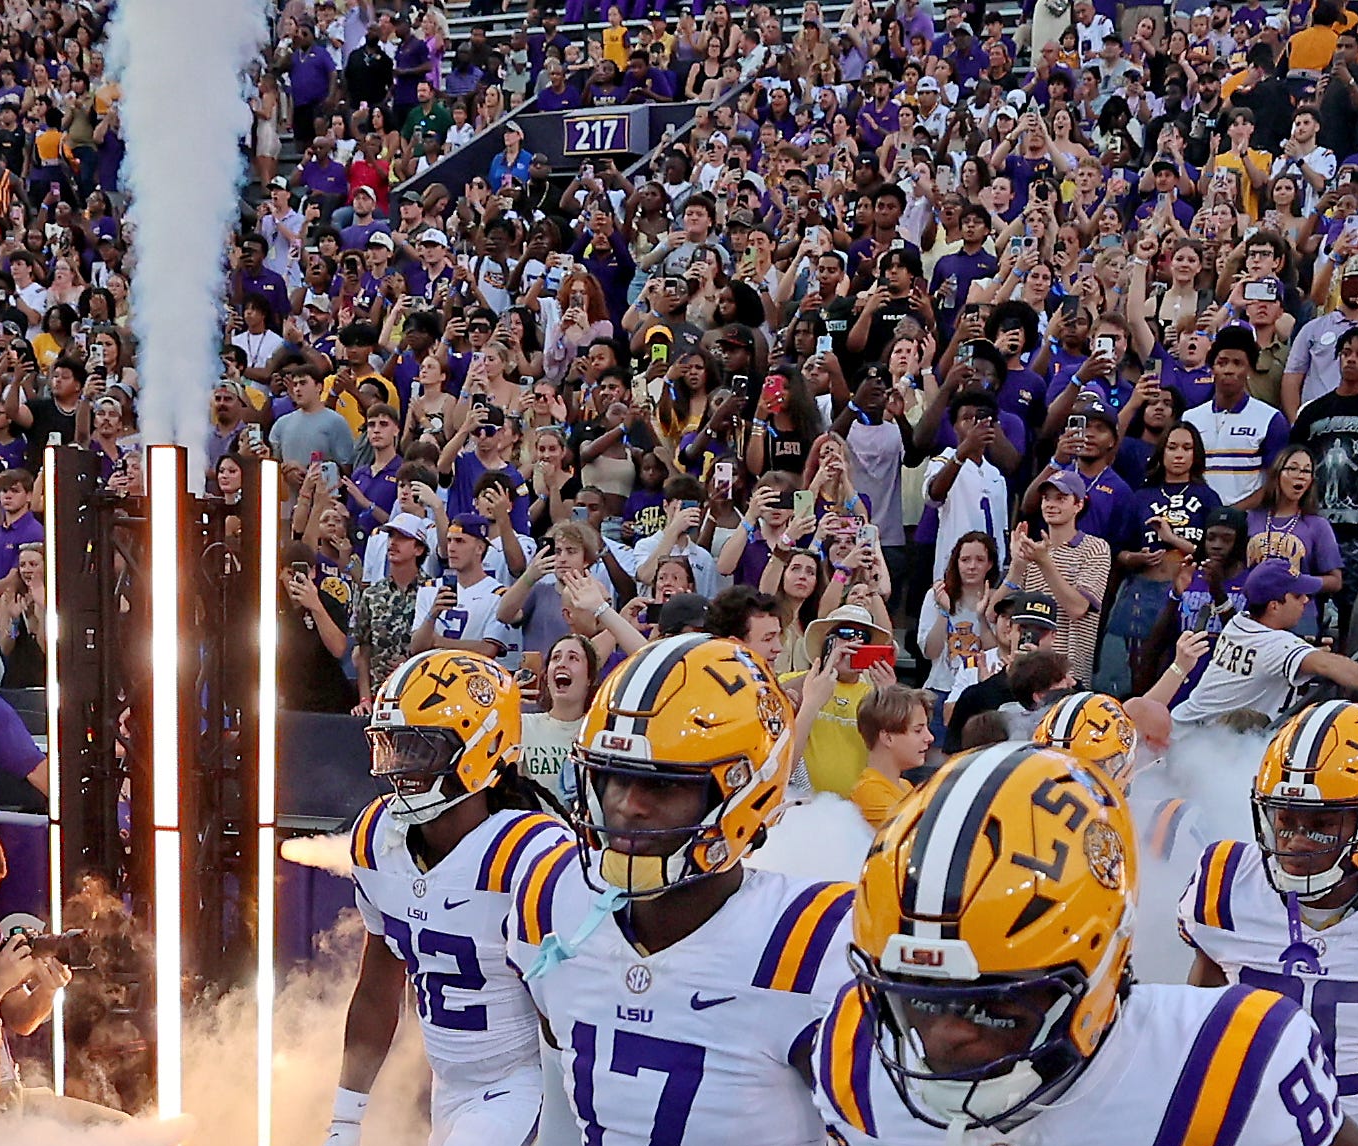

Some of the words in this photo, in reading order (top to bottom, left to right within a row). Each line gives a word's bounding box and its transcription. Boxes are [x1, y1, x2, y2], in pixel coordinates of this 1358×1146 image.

[575, 121, 618, 151] 217
[1230, 426, 1257, 437] LSU
[1148, 493, 1204, 521] LSU
[1144, 526, 1204, 547] TERS
[1025, 601, 1052, 615] LSU
[600, 735, 634, 752] LSU
[530, 759, 564, 776] GAM
[407, 906, 428, 922] LSU
[899, 946, 944, 967] LSU
[616, 1005, 654, 1024] LSU
